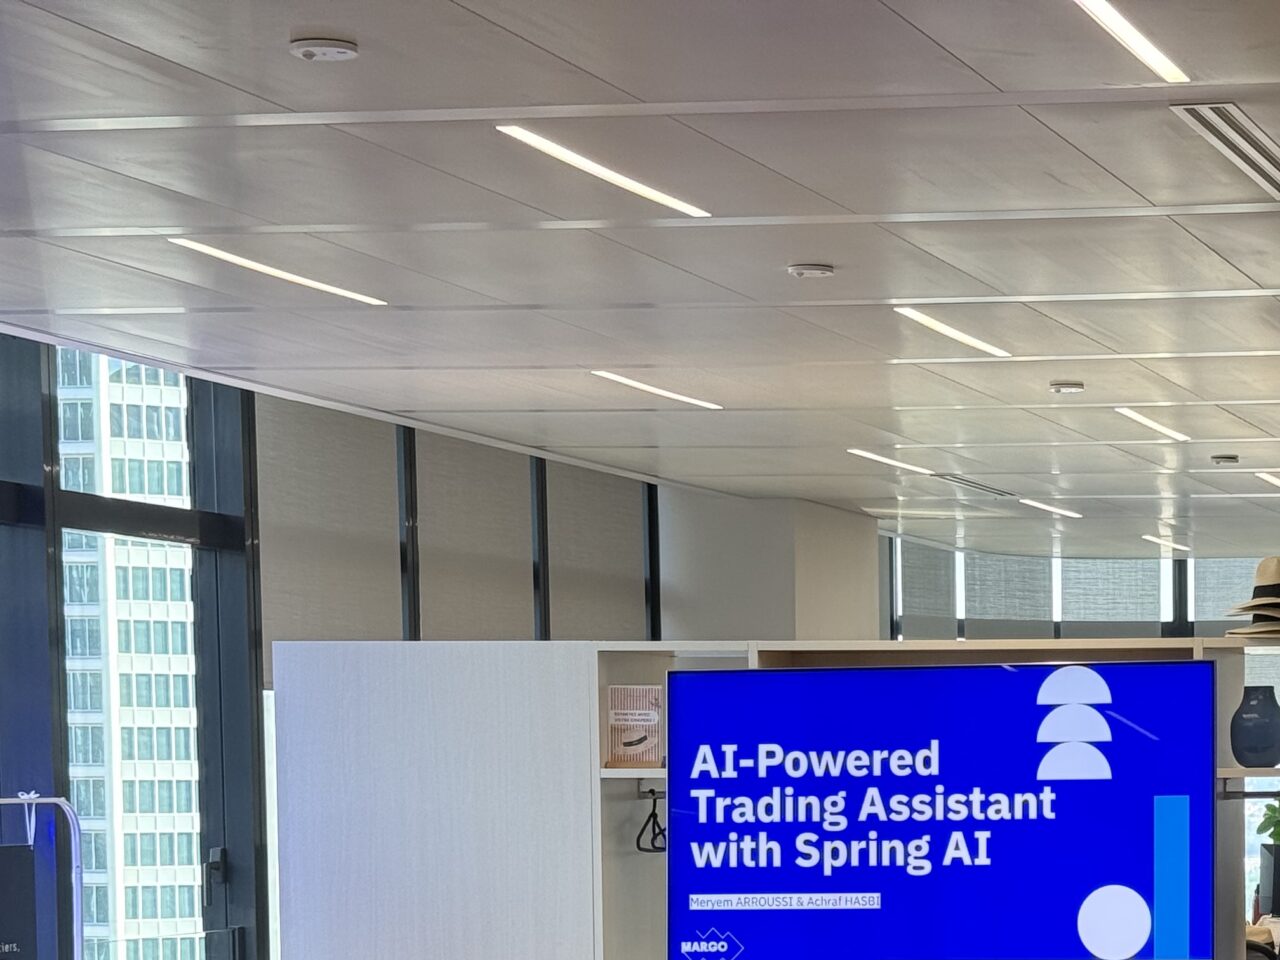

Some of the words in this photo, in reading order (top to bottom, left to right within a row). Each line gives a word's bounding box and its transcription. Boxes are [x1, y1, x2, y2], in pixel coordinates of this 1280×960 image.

[690, 739, 940, 779] AI-Powered
[690, 786, 848, 832] Trading
[858, 784, 1056, 822] Assistant
[690, 831, 782, 868] with
[795, 830, 932, 877] Spring
[942, 830, 991, 866] AI
[690, 896, 733, 909] Meryem
[736, 896, 793, 907] ARROUSSI
[796, 896, 805, 907] &
[807, 895, 842, 907] Achraf
[844, 895, 880, 907] HASBI
[681, 941, 728, 953] MARGO
